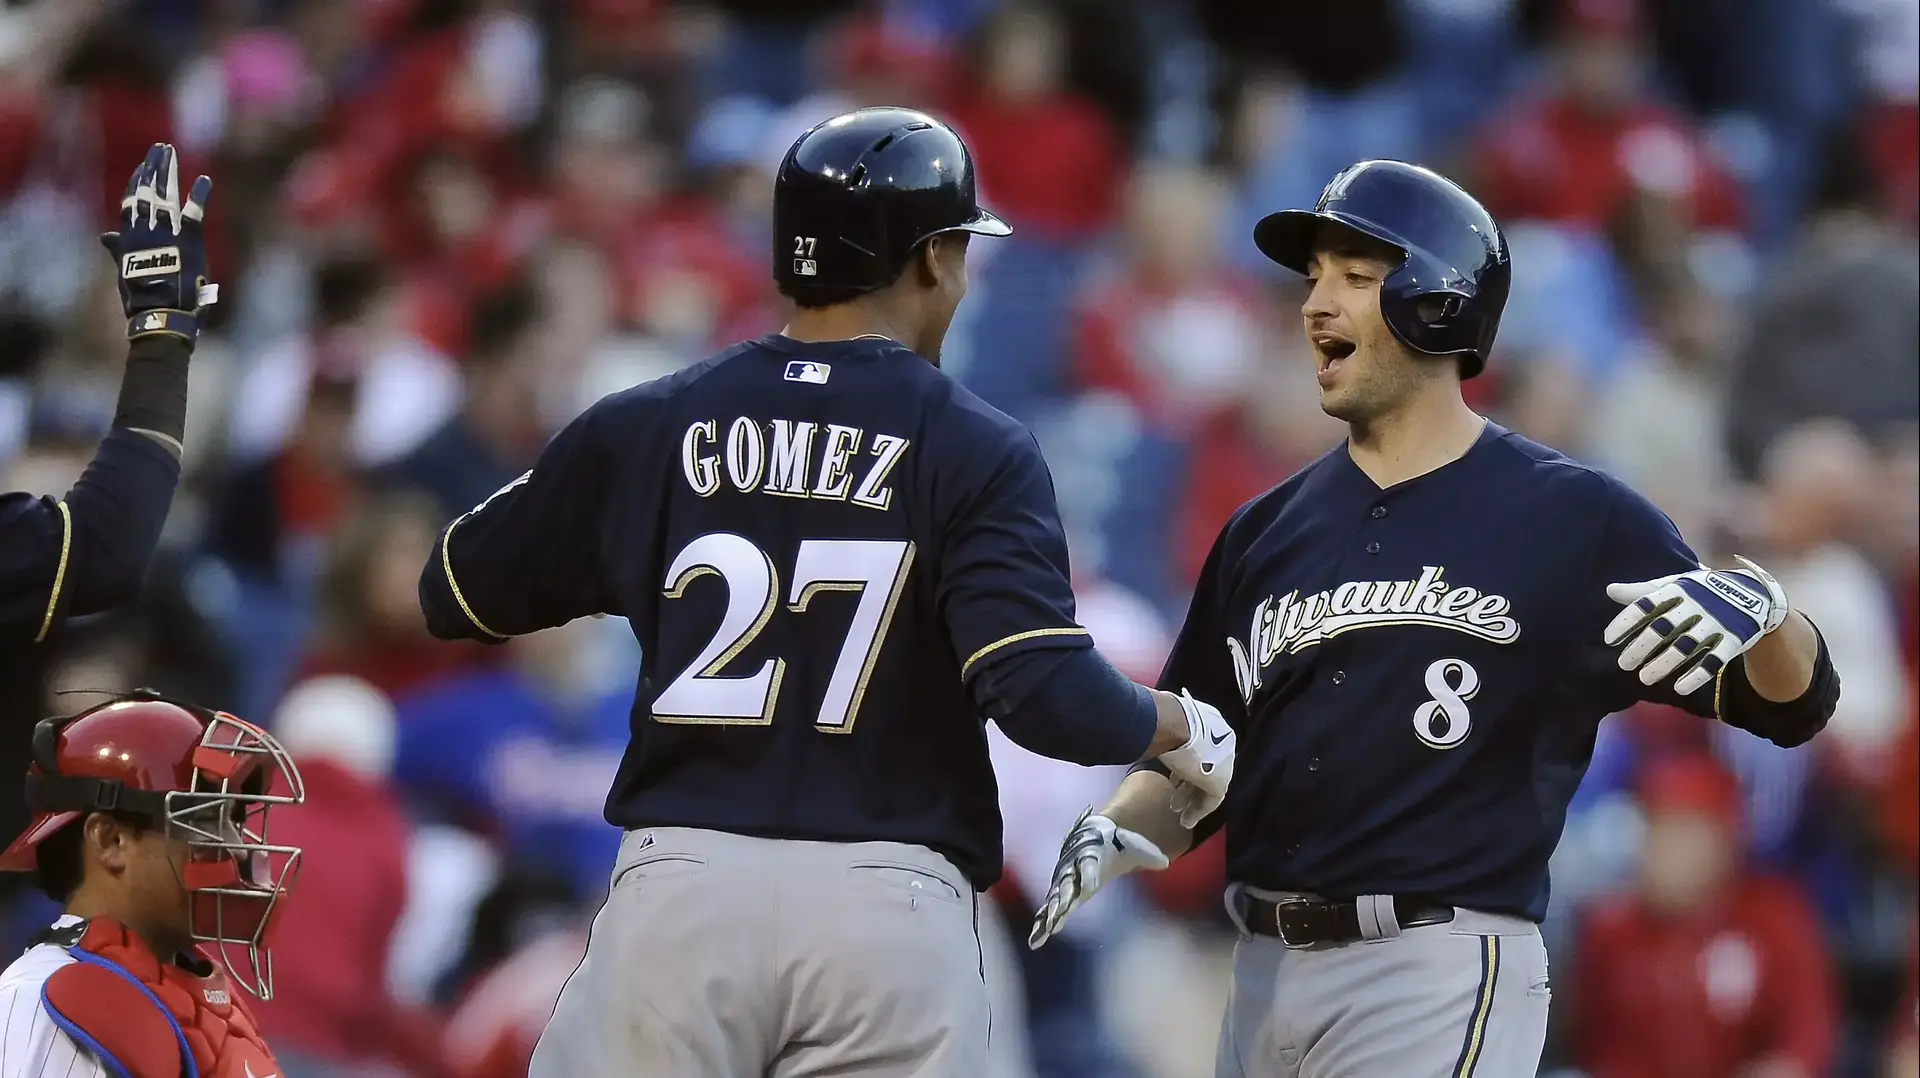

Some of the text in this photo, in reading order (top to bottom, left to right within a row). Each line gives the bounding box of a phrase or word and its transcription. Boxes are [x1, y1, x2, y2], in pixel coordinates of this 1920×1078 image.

[795, 236, 817, 257] 27
[682, 416, 910, 511] GOMEZ
[651, 531, 917, 735] 27
[1226, 565, 1521, 705] Milwaukee
[1413, 657, 1481, 750] 8
